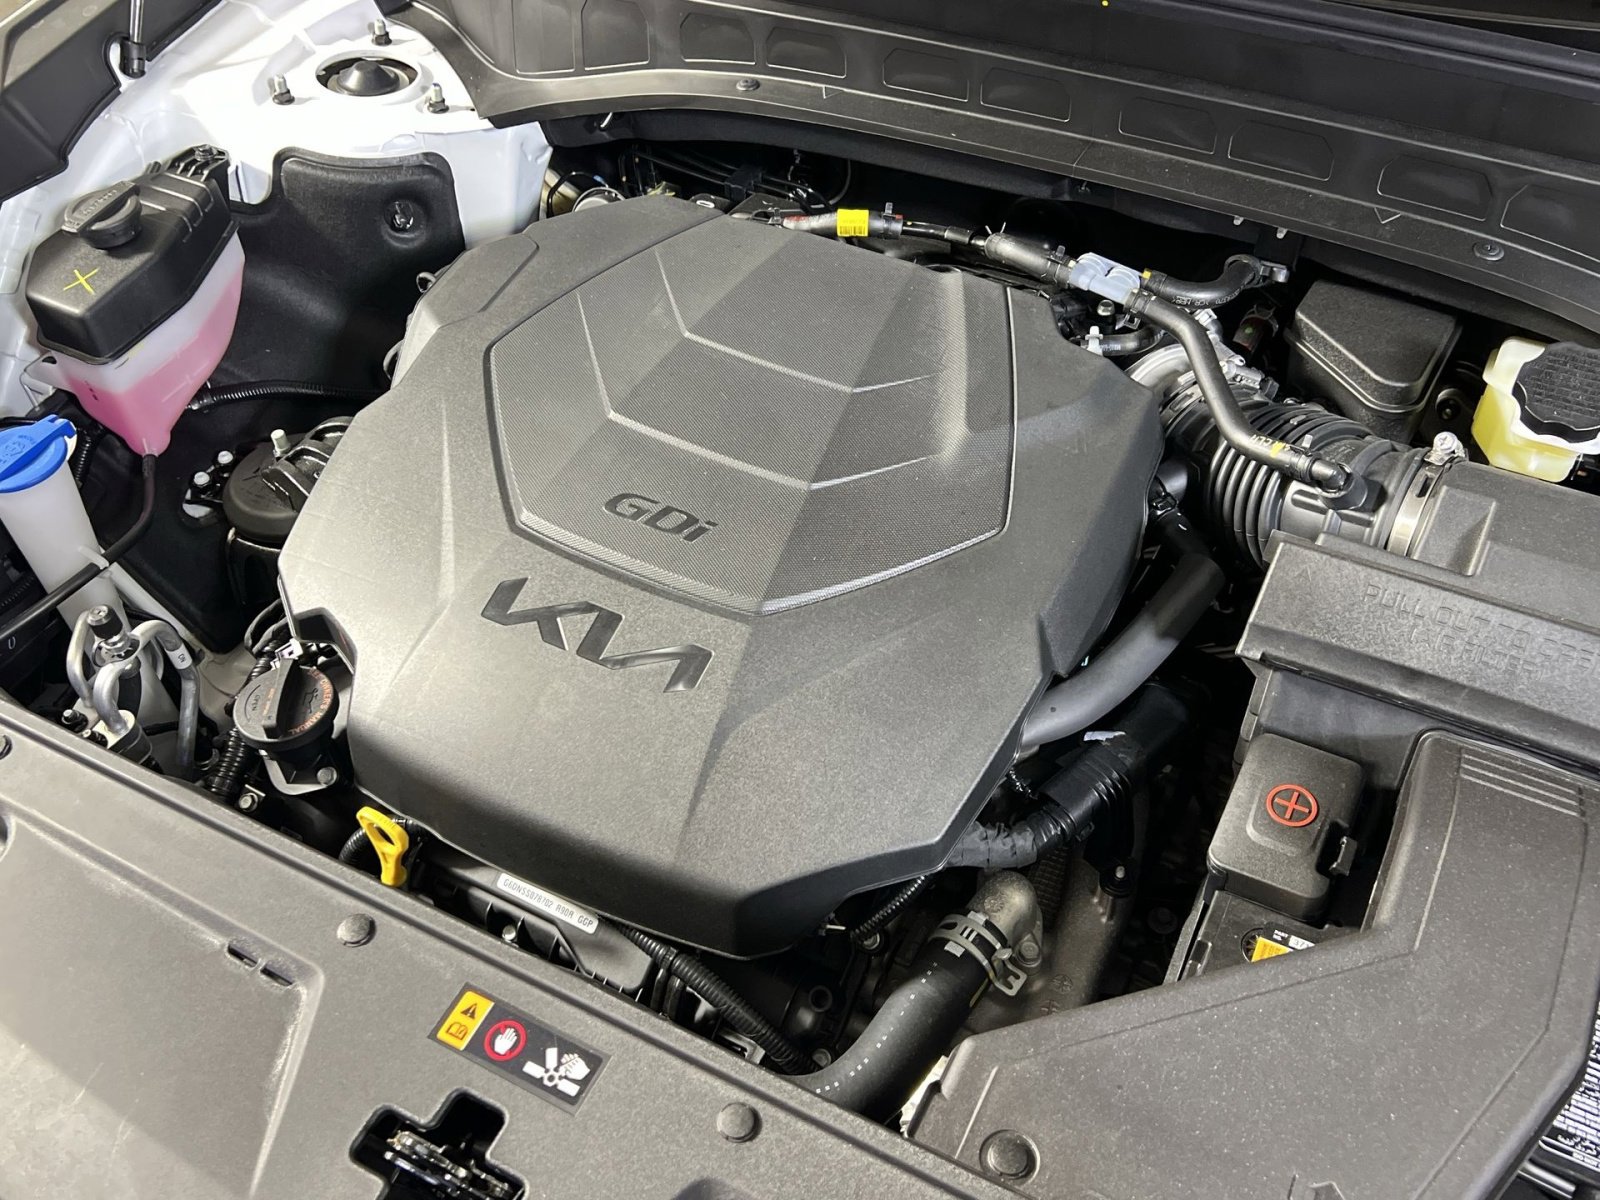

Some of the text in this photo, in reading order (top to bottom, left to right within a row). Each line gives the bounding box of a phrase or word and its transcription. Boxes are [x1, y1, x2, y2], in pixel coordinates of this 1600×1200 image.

[602, 492, 719, 543] GDi
[1364, 583, 1425, 619] PULL
[1435, 606, 1492, 634] OUT
